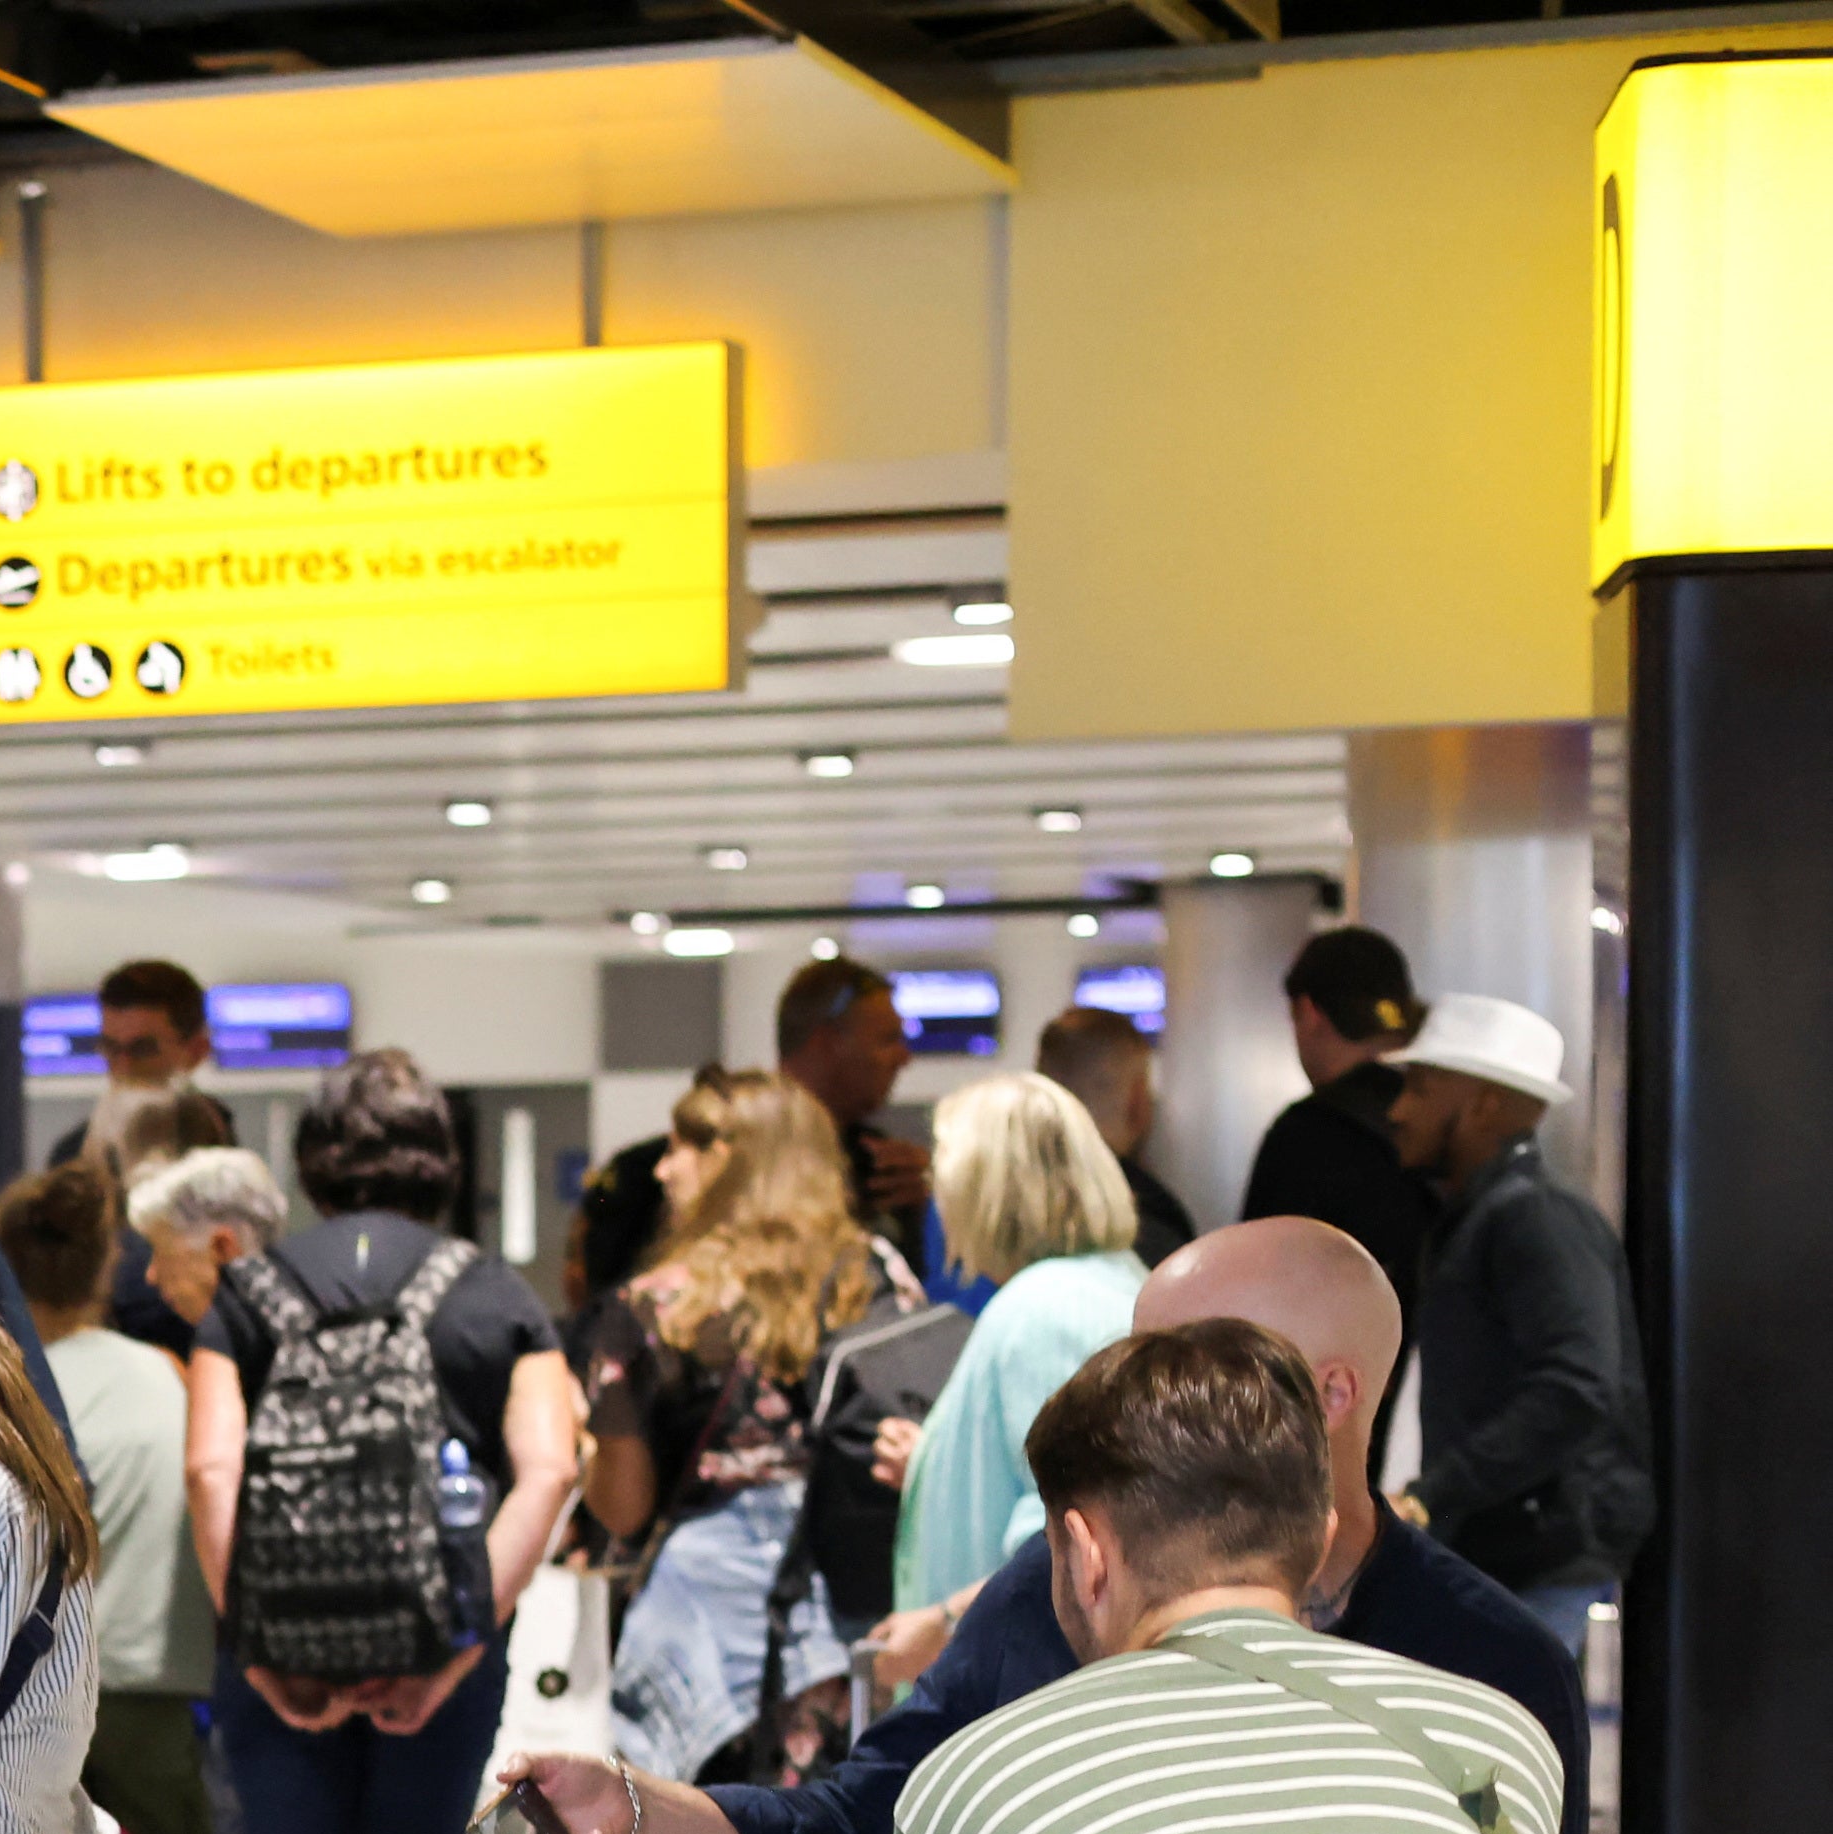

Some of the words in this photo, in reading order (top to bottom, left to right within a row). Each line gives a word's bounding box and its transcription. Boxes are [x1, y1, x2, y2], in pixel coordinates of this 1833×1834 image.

[56, 457, 163, 505] Lifts
[183, 453, 235, 495] to
[252, 440, 549, 499] departures
[57, 544, 351, 603] Departures
[364, 549, 425, 581] via
[437, 536, 623, 576] escalator
[205, 642, 336, 680] Toilets
